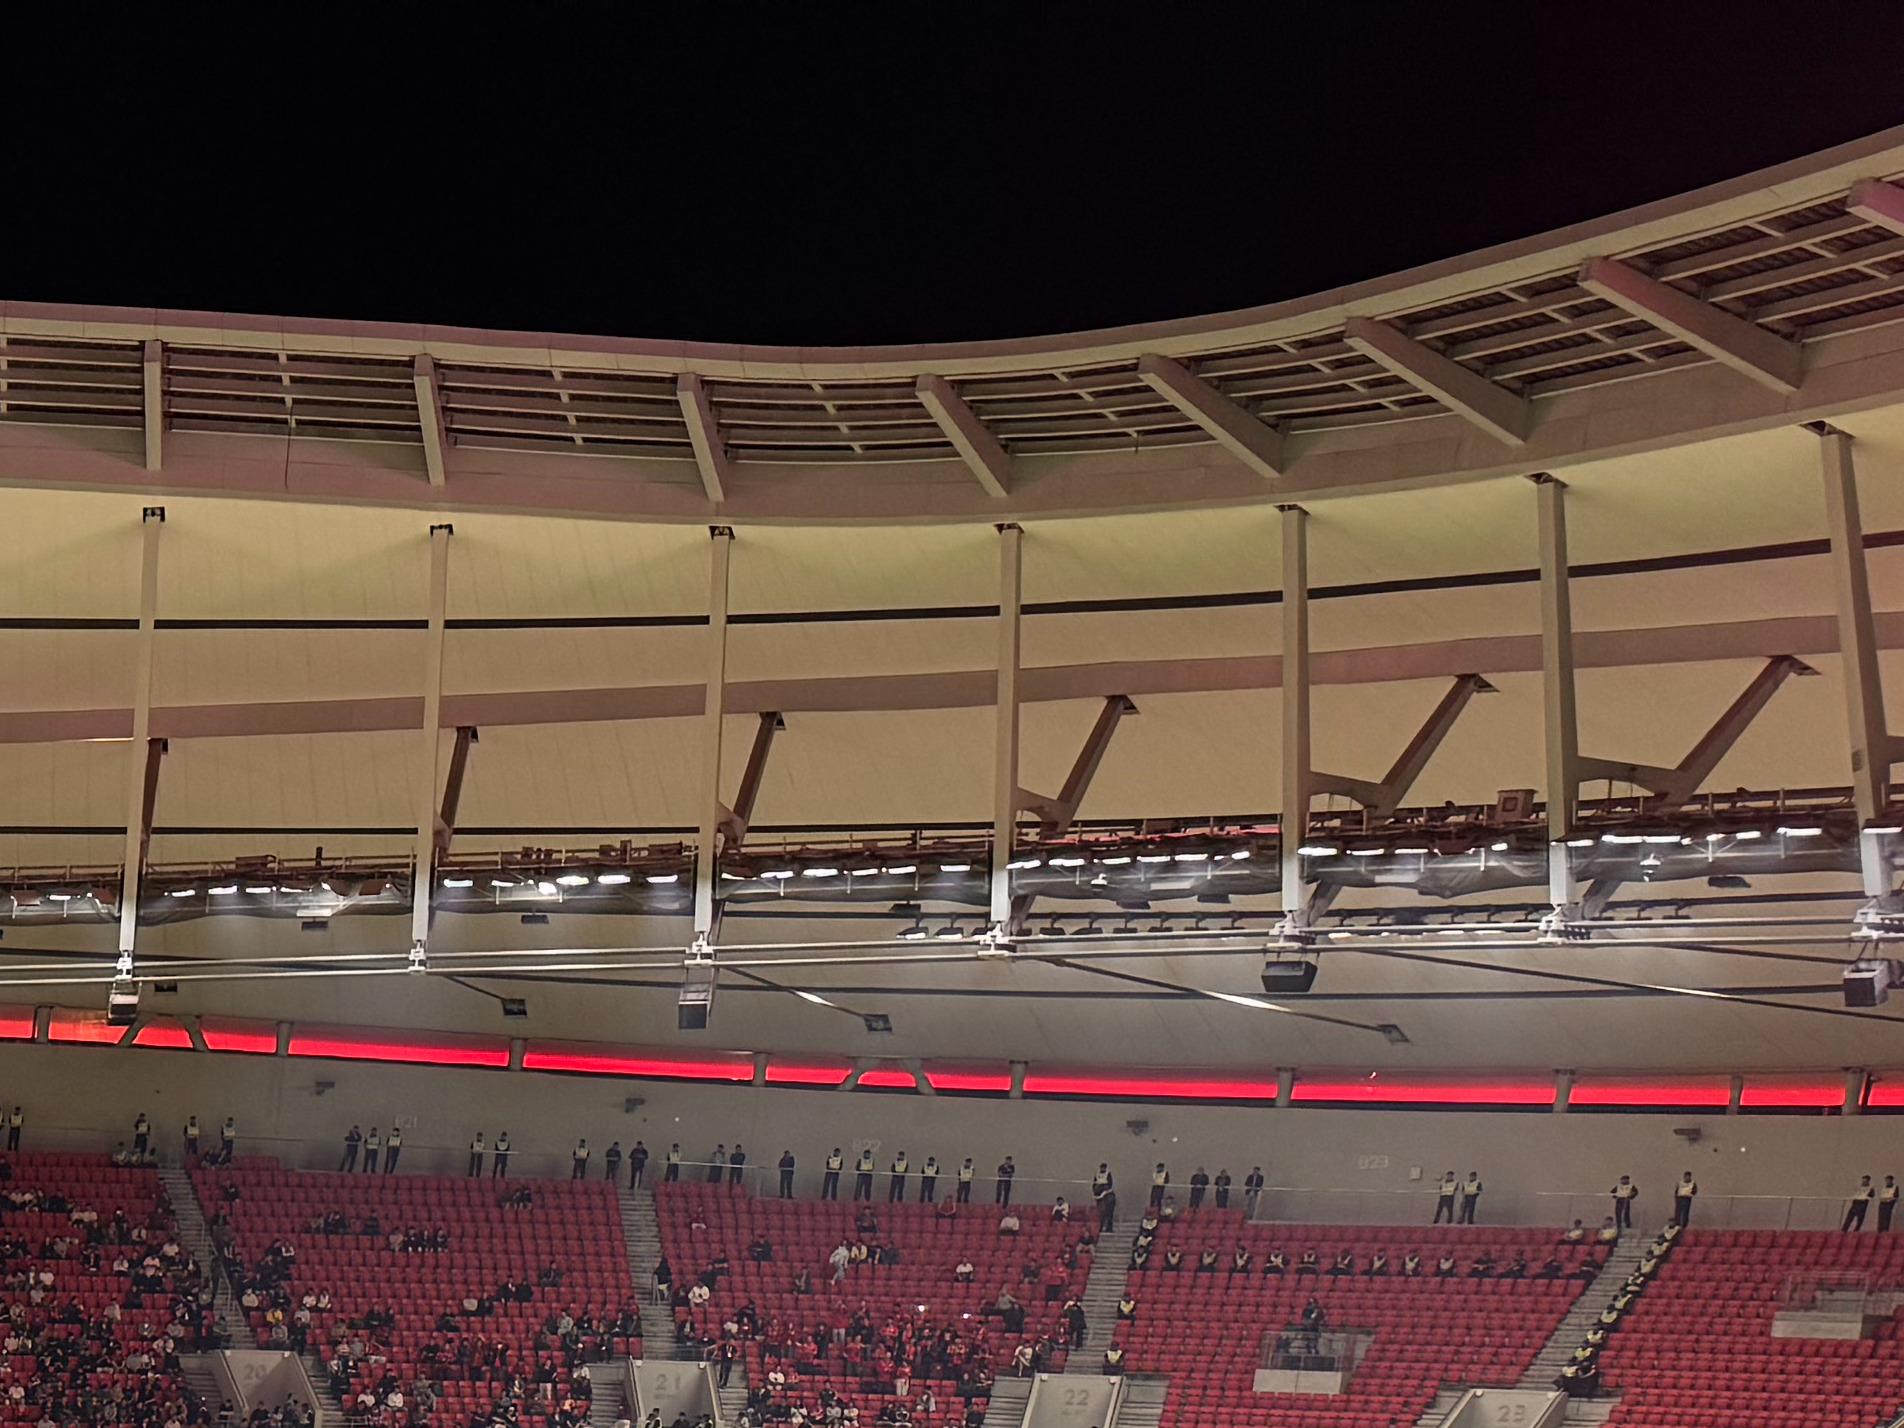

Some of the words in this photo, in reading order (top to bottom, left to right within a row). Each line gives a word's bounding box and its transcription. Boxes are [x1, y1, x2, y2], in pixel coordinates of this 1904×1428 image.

[655, 1373, 681, 1391] 21
[1064, 1389, 1089, 1407] 22
[1497, 1404, 1526, 1423] 23
